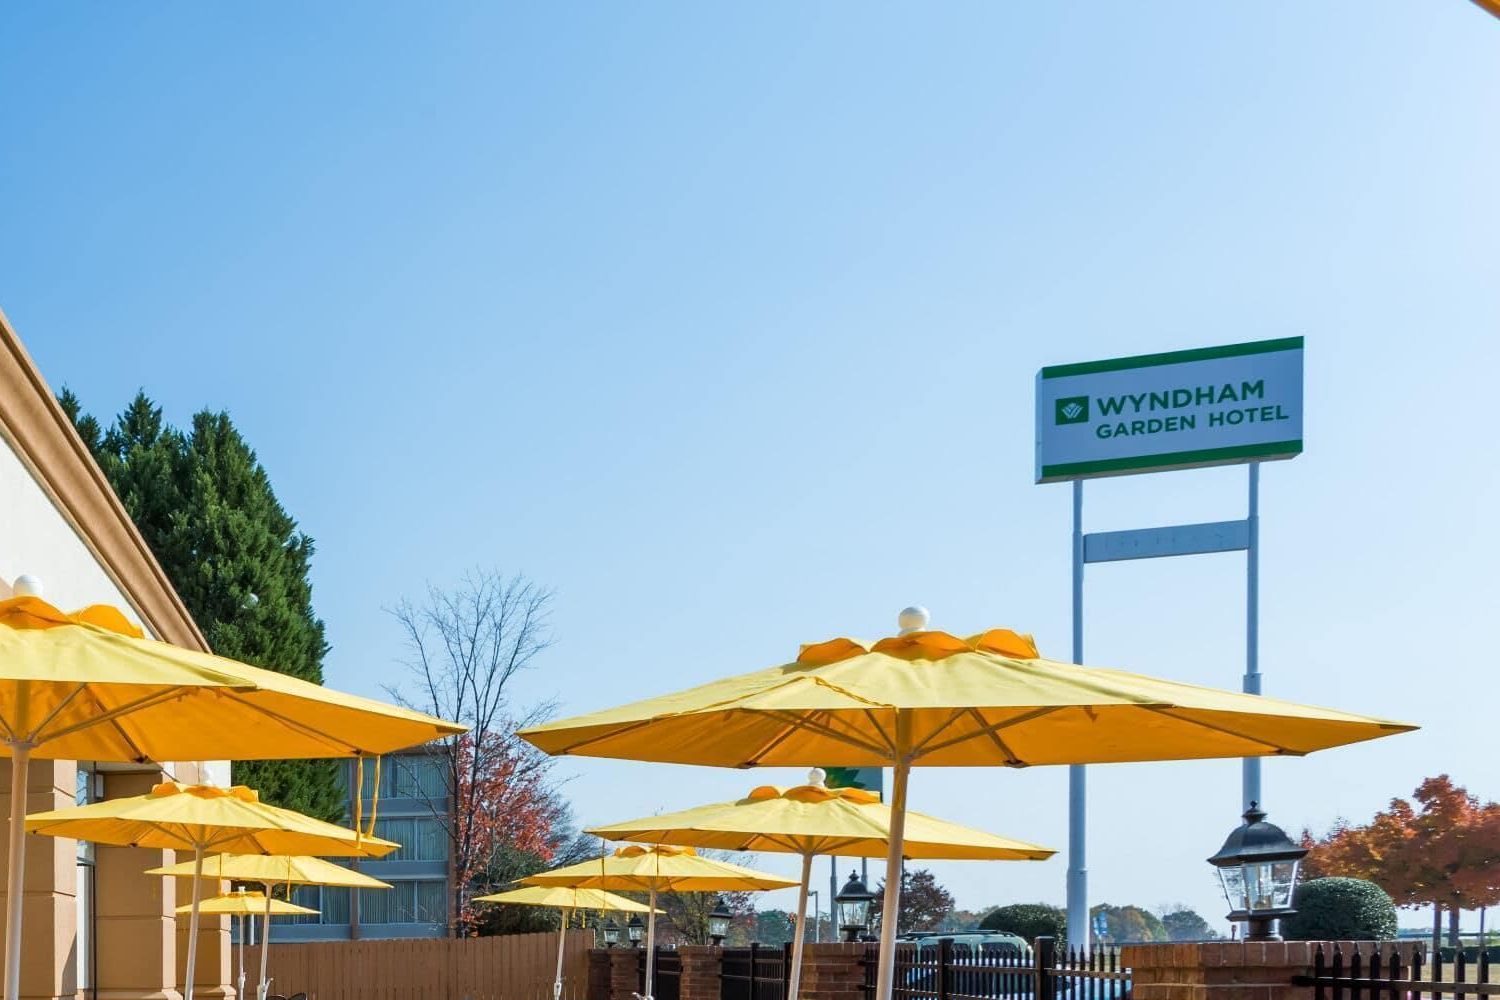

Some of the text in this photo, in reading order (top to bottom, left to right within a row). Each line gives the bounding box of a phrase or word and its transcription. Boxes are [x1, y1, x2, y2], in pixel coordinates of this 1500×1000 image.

[1096, 379, 1265, 416] WYNDHAM
[1095, 404, 1290, 440] GARDEN HOTEL
